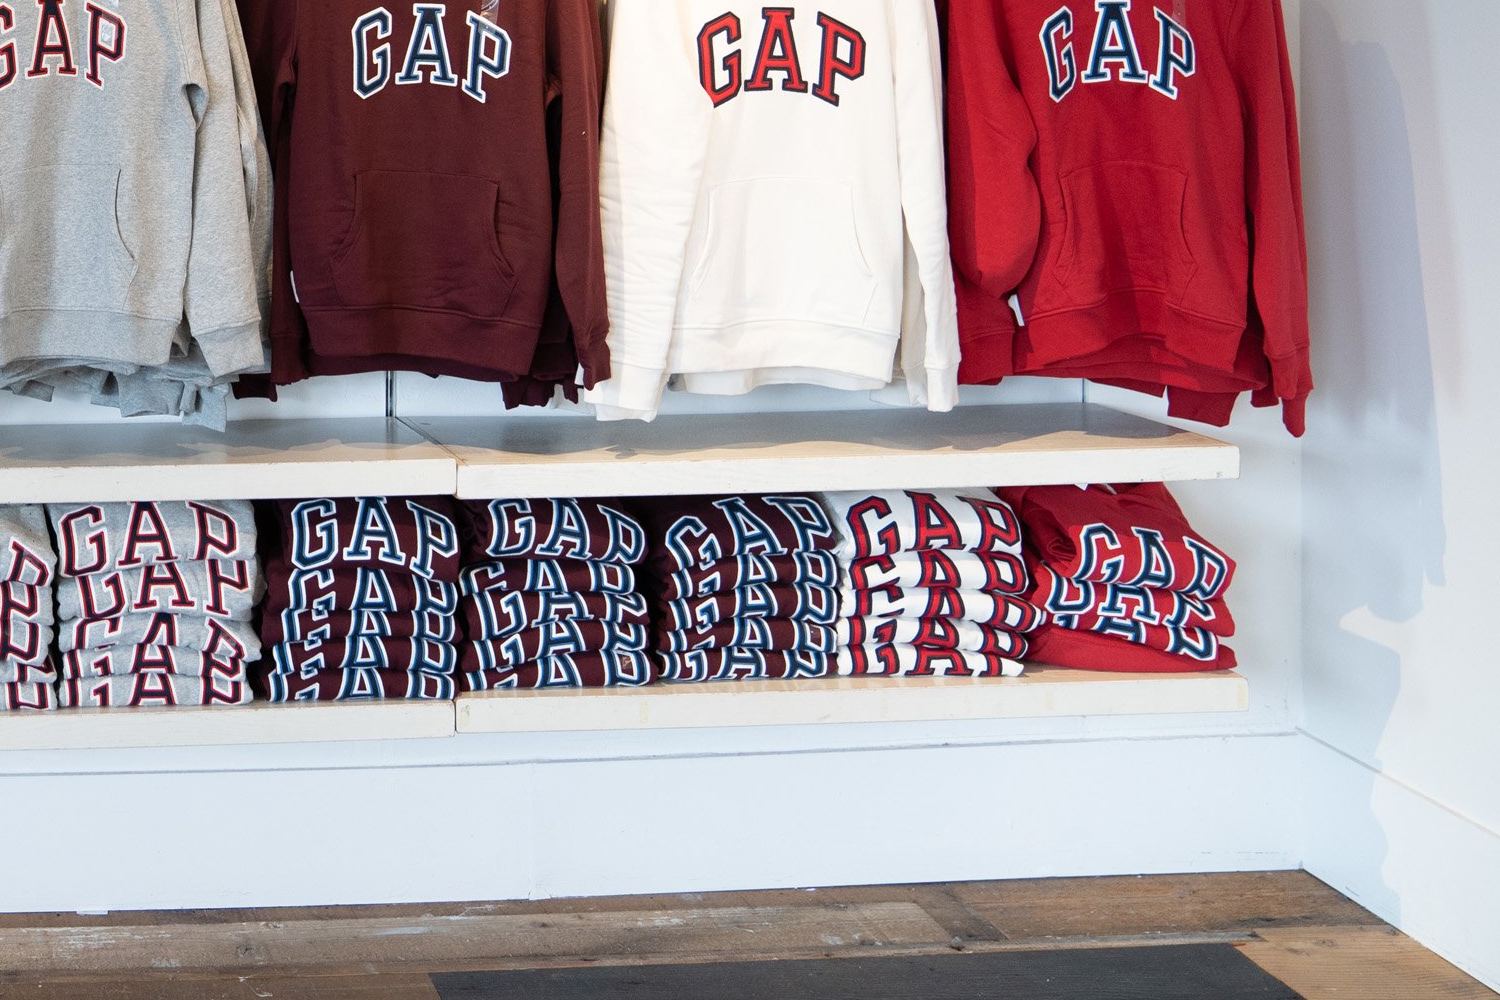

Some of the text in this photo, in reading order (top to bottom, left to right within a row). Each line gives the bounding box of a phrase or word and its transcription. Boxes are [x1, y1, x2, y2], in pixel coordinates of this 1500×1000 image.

[351, 3, 512, 103] GAP
[697, 7, 866, 108] GAP
[61, 501, 237, 576] GAP
[292, 498, 458, 579] GAP
[487, 498, 646, 564] GAP
[666, 496, 833, 571] GAP
[847, 490, 1021, 558] GAP
[1074, 522, 1229, 599] GAP
